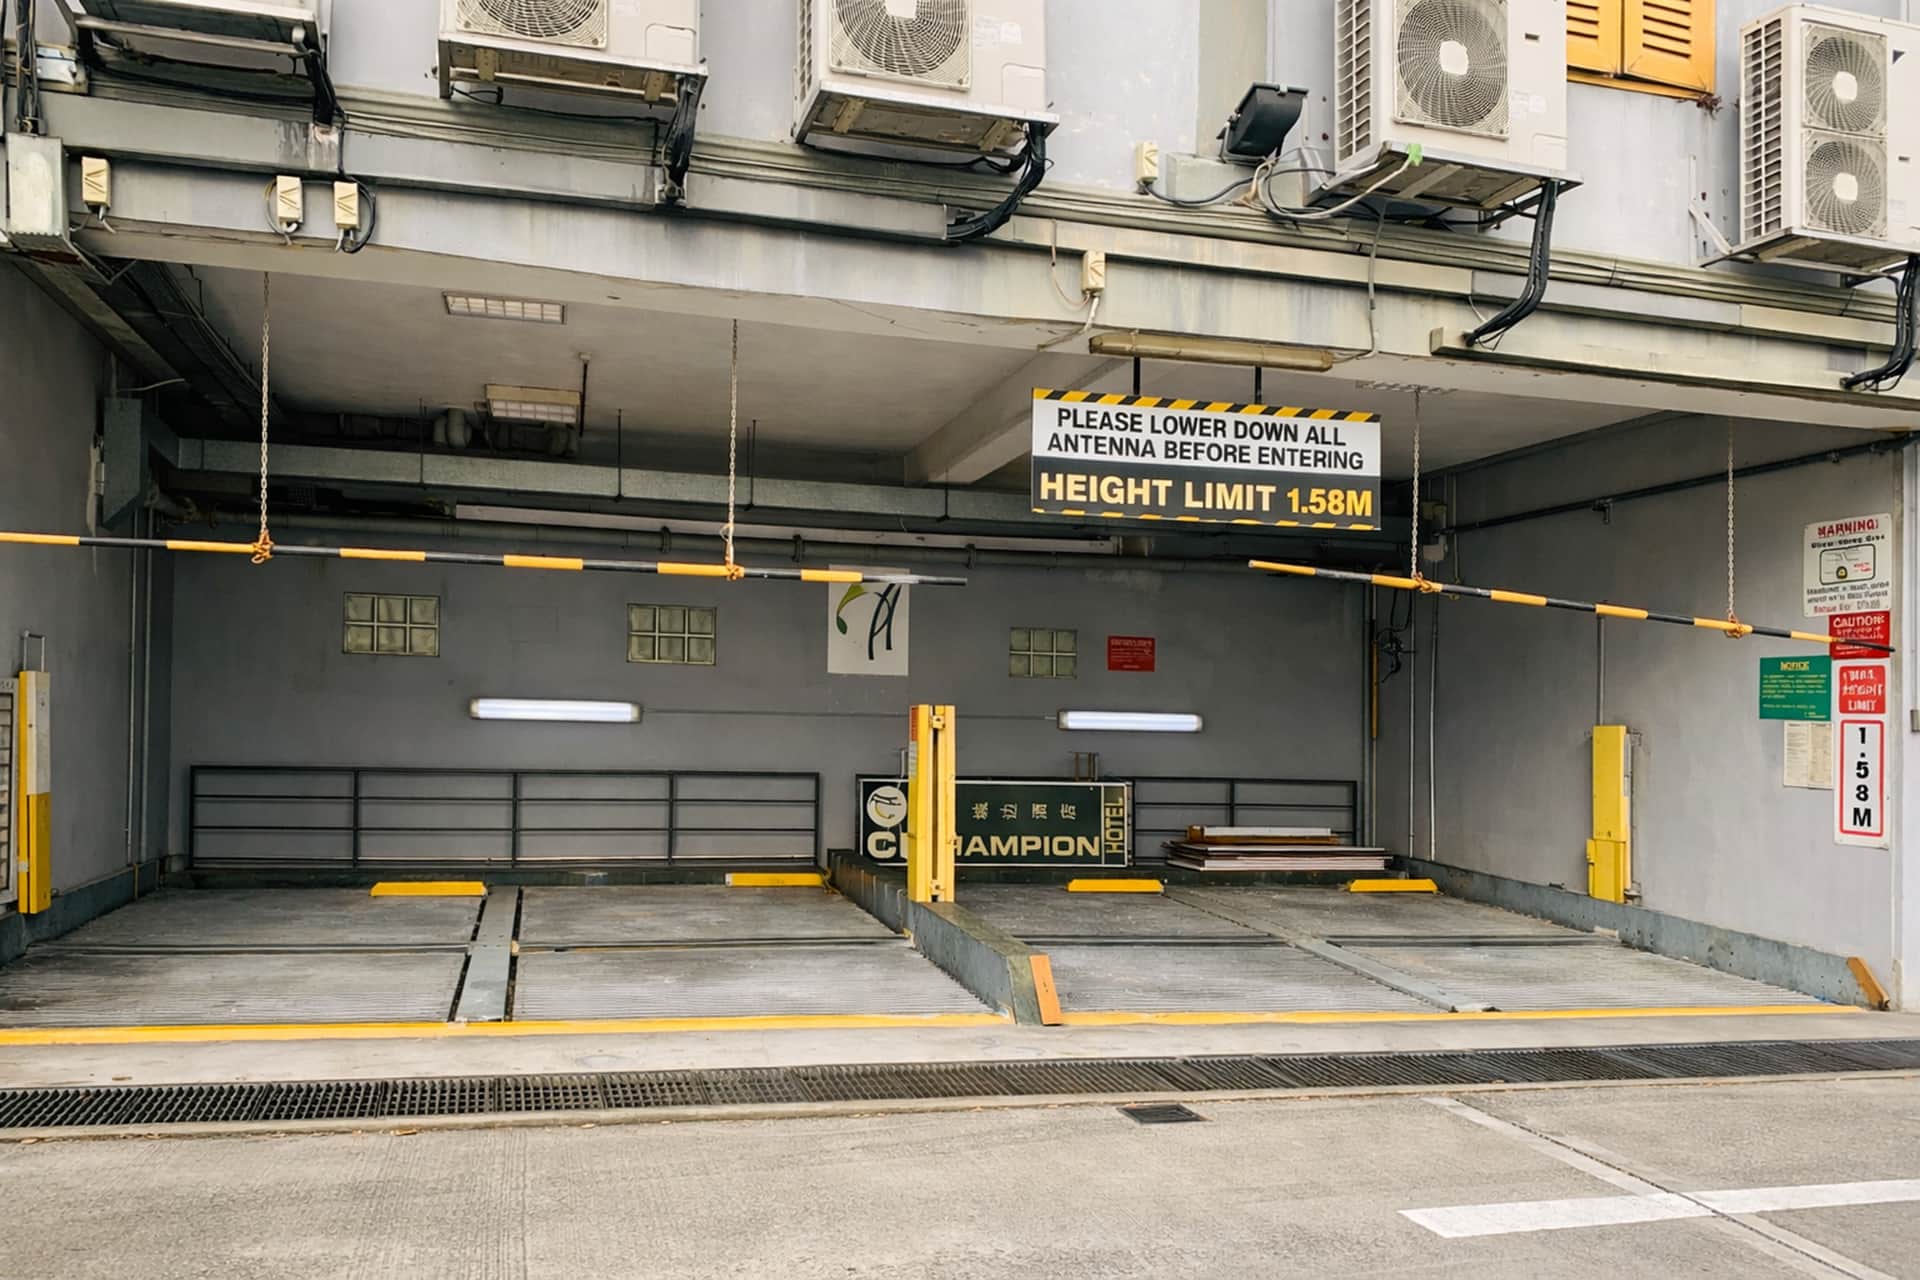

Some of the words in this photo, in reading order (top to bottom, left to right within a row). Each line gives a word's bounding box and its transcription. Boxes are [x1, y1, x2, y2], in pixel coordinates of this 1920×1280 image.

[1057, 407, 1143, 433] PLEASE
[1150, 414, 1227, 438] LOWER
[1234, 420, 1298, 443] DOWN
[1305, 425, 1346, 446] ALL
[1047, 432, 1156, 458] ANTENNA
[1164, 440, 1251, 464] BEFORE
[1258, 446, 1364, 470] ENTERING
[1040, 472, 1173, 507] HEIGHT
[1184, 481, 1277, 512] LIMIT
[1287, 487, 1373, 517] 1.58M
[1853, 727, 1872, 828] 1.58M
[1104, 797, 1124, 854] HOTEL
